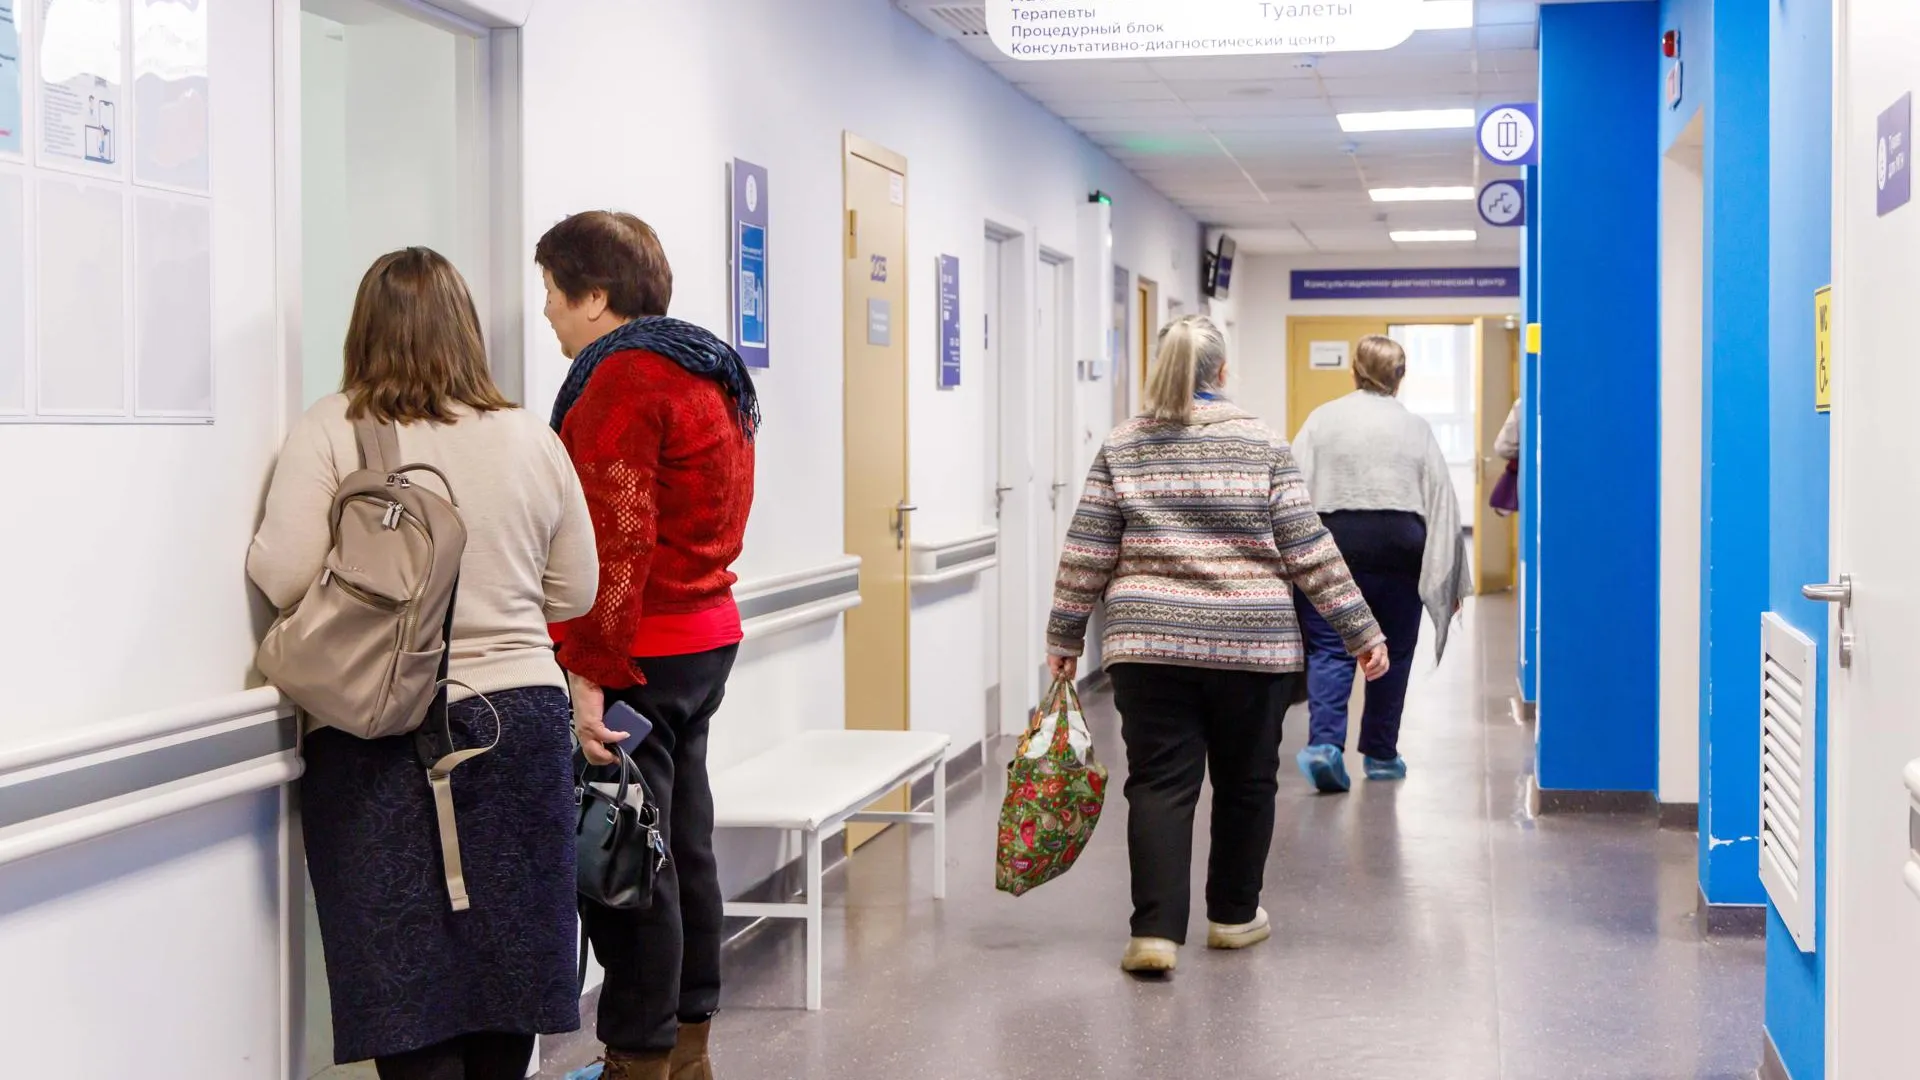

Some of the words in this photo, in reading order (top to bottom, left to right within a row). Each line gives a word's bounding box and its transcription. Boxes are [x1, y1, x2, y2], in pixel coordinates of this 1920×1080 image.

[1011, 8, 1096, 22] Терапевты
[1258, 2, 1352, 21] Туалеты
[1011, 22, 1121, 38] Процедурный
[1126, 21, 1165, 34] блок
[1011, 36, 1283, 55] Консультативно-диагностический
[1288, 35, 1336, 47] центр
[1476, 277, 1505, 288] центр
